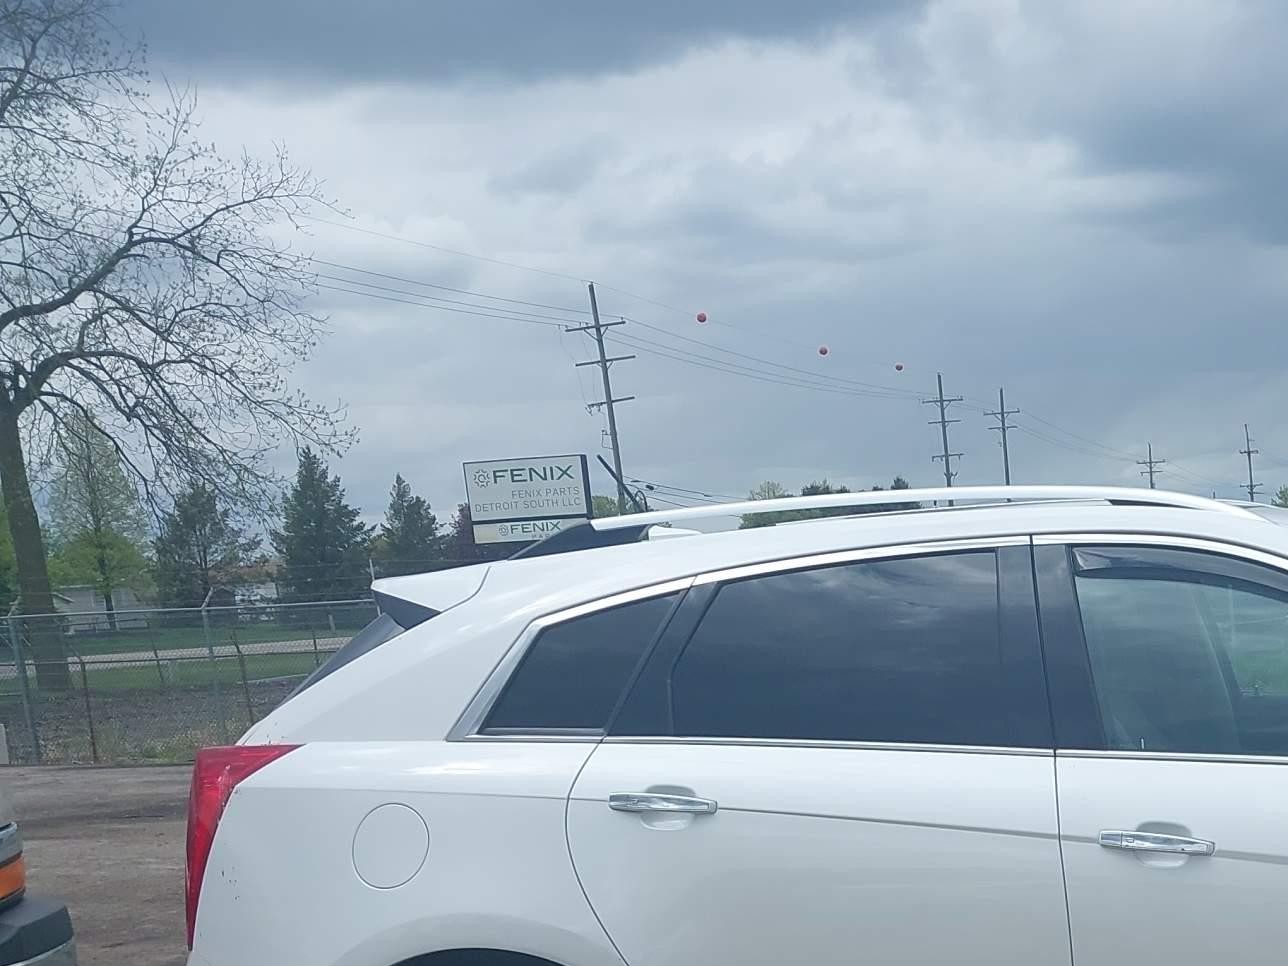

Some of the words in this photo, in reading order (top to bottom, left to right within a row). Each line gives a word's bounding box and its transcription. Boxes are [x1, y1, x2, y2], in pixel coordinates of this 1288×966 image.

[493, 465, 574, 484] FENIX
[511, 488, 542, 499] FENIX
[545, 486, 580, 496] PARTS
[475, 501, 519, 512] DETROIT
[524, 499, 559, 509] SOUTH
[562, 497, 581, 506] LLC
[511, 521, 561, 534] FENIX
